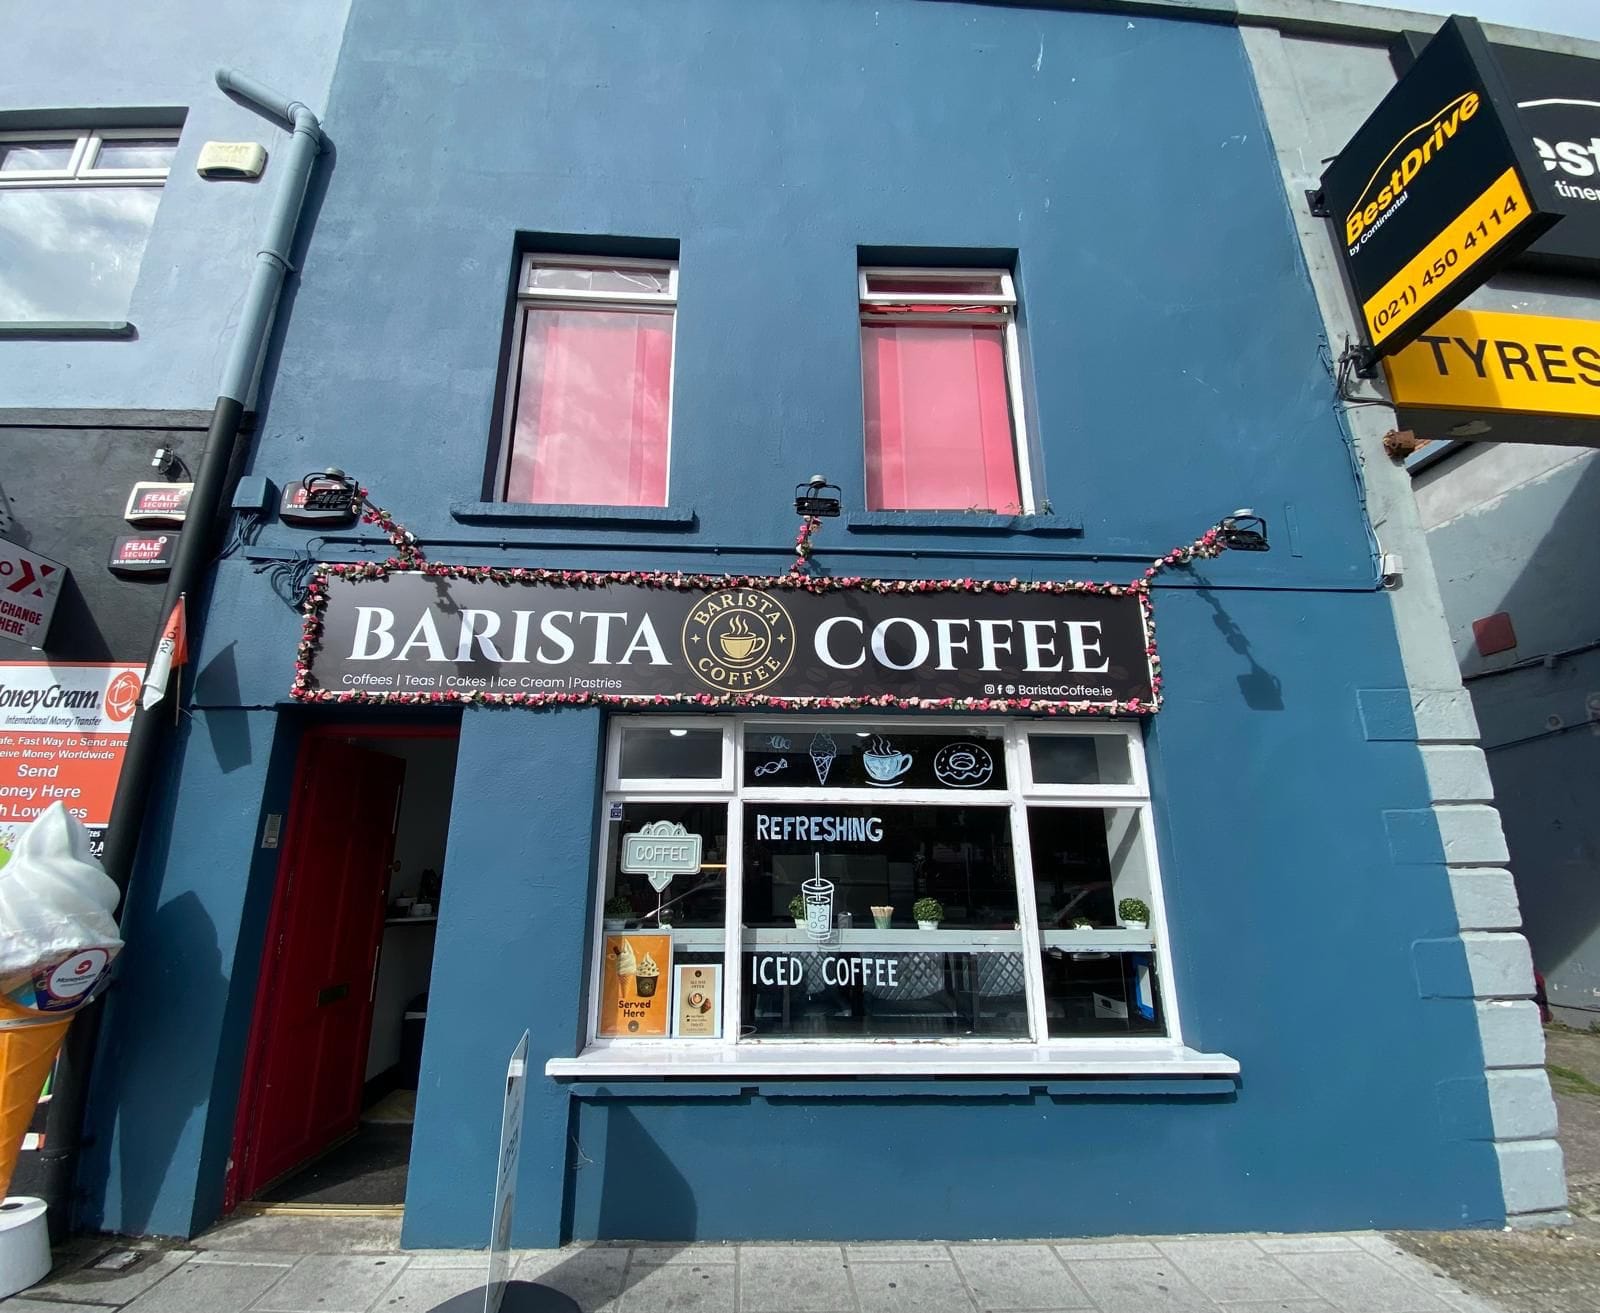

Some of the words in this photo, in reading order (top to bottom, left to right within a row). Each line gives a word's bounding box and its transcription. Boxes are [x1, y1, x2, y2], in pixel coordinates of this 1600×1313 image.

[1346, 92, 1480, 247] BestDrive
[1349, 242, 1360, 257] by
[1360, 190, 1409, 244] Continental
[1373, 285, 1417, 334] (021)
[1422, 248, 1458, 288] 450
[1464, 195, 1518, 250] 4114
[1417, 334, 1600, 387] TYRES
[144, 494, 180, 502] FEALE
[125, 542, 161, 551] FEALE
[0, 599, 43, 625] CHANGE
[694, 592, 781, 626] BARISTA
[345, 605, 673, 667] BARISTA
[813, 615, 1110, 674] COFFEE
[698, 656, 781, 686] COFFEE
[342, 674, 393, 686] Coffees
[404, 675, 435, 687] Teas
[446, 675, 487, 688] Cakes
[497, 676, 517, 688] Ice
[520, 677, 565, 689] Cream
[573, 677, 623, 689] Pastries
[1018, 684, 1113, 697] BaristaCoffee.ie
[5, 715, 49, 725] International
[49, 716, 74, 728] Money
[74, 716, 103, 726] Transfer
[0, 736, 15, 747] afe,
[18, 736, 40, 746] Fast
[42, 737, 64, 748] Way
[66, 738, 77, 747] to
[80, 738, 107, 748] Send
[0, 749, 20, 758] eive
[22, 749, 56, 760] Money
[58, 750, 115, 760] Worldwide
[17, 763, 59, 778] Send
[0, 785, 37, 800] oney
[41, 784, 81, 798] Here
[756, 814, 884, 842] REFRESHING
[752, 955, 803, 987] ICED
[821, 956, 899, 988] COFFEE
[618, 999, 651, 1009] Served
[623, 1009, 646, 1018] Here
